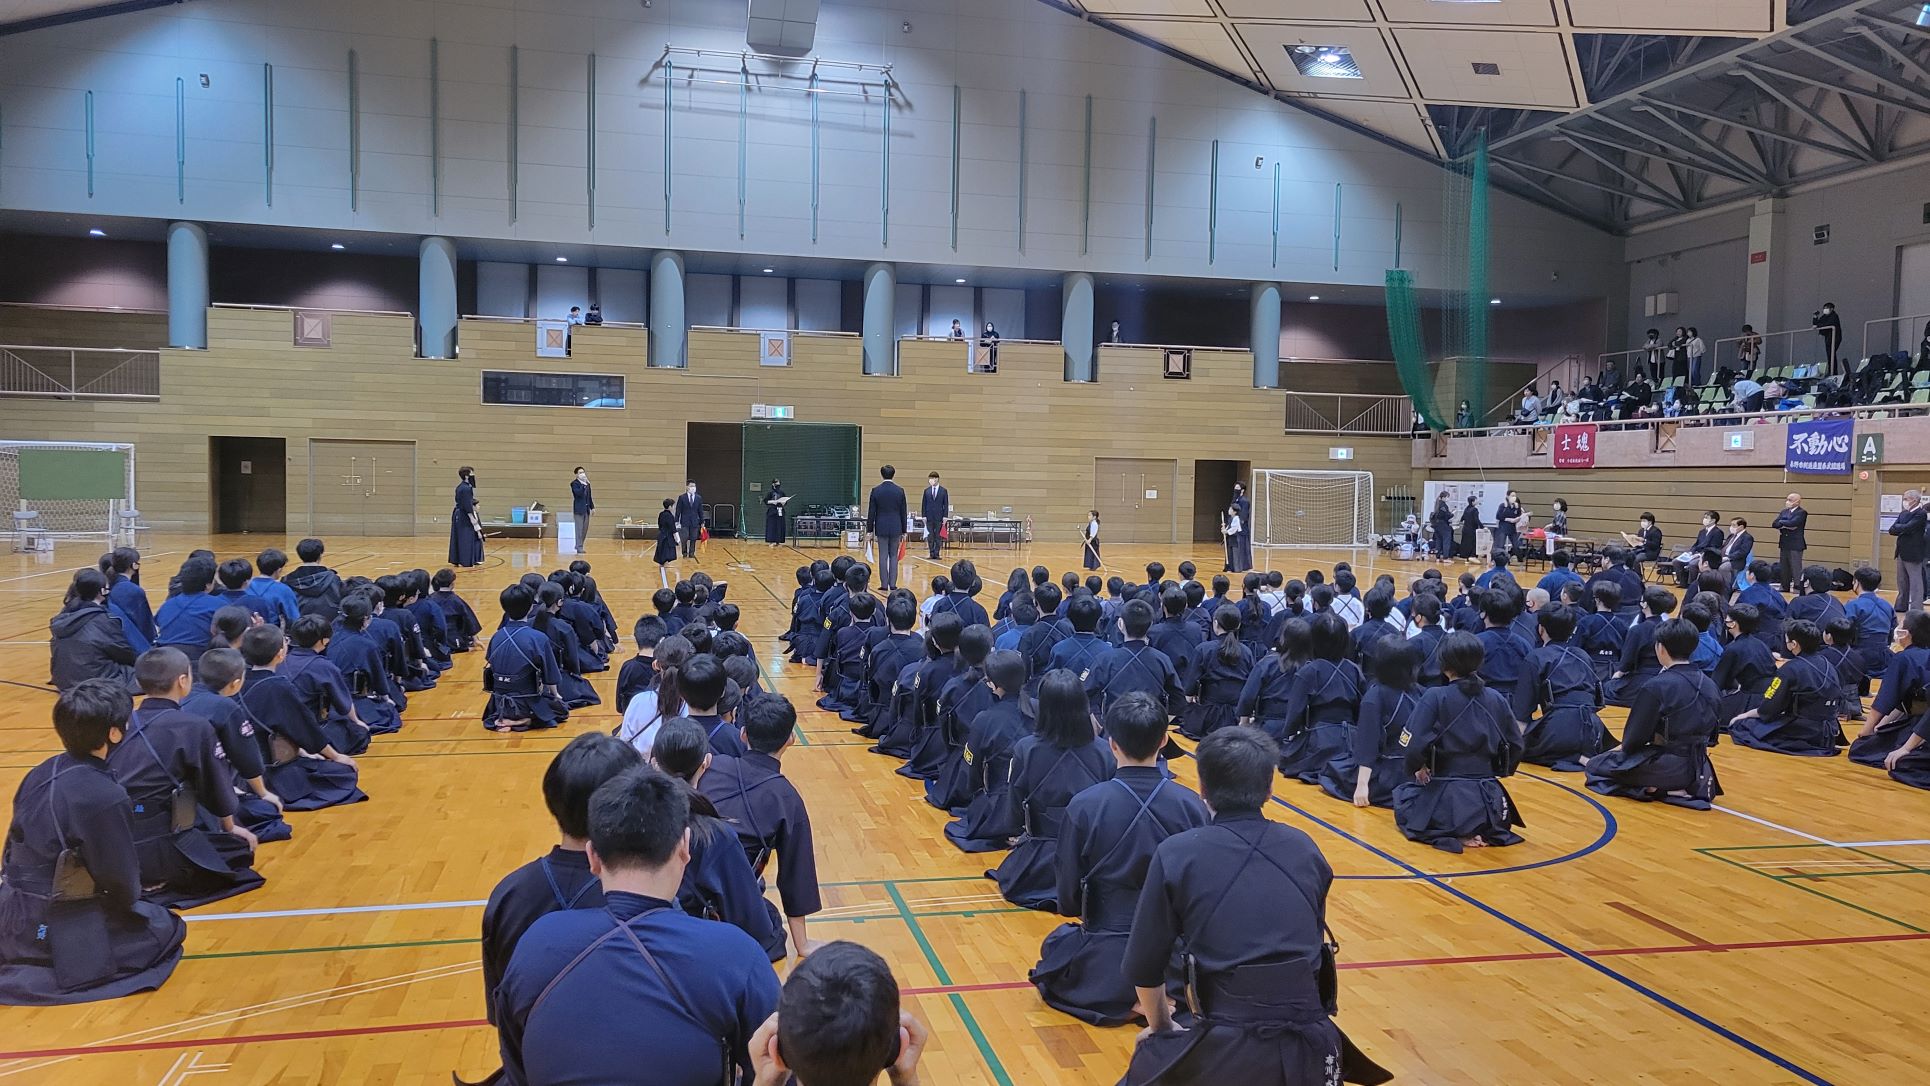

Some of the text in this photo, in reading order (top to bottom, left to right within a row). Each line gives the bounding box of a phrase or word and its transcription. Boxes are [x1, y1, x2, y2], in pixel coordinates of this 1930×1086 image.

[1789, 432, 1849, 455] 不動心
[1863, 436, 1876, 455] A
[1861, 455, 1877, 463] コート
